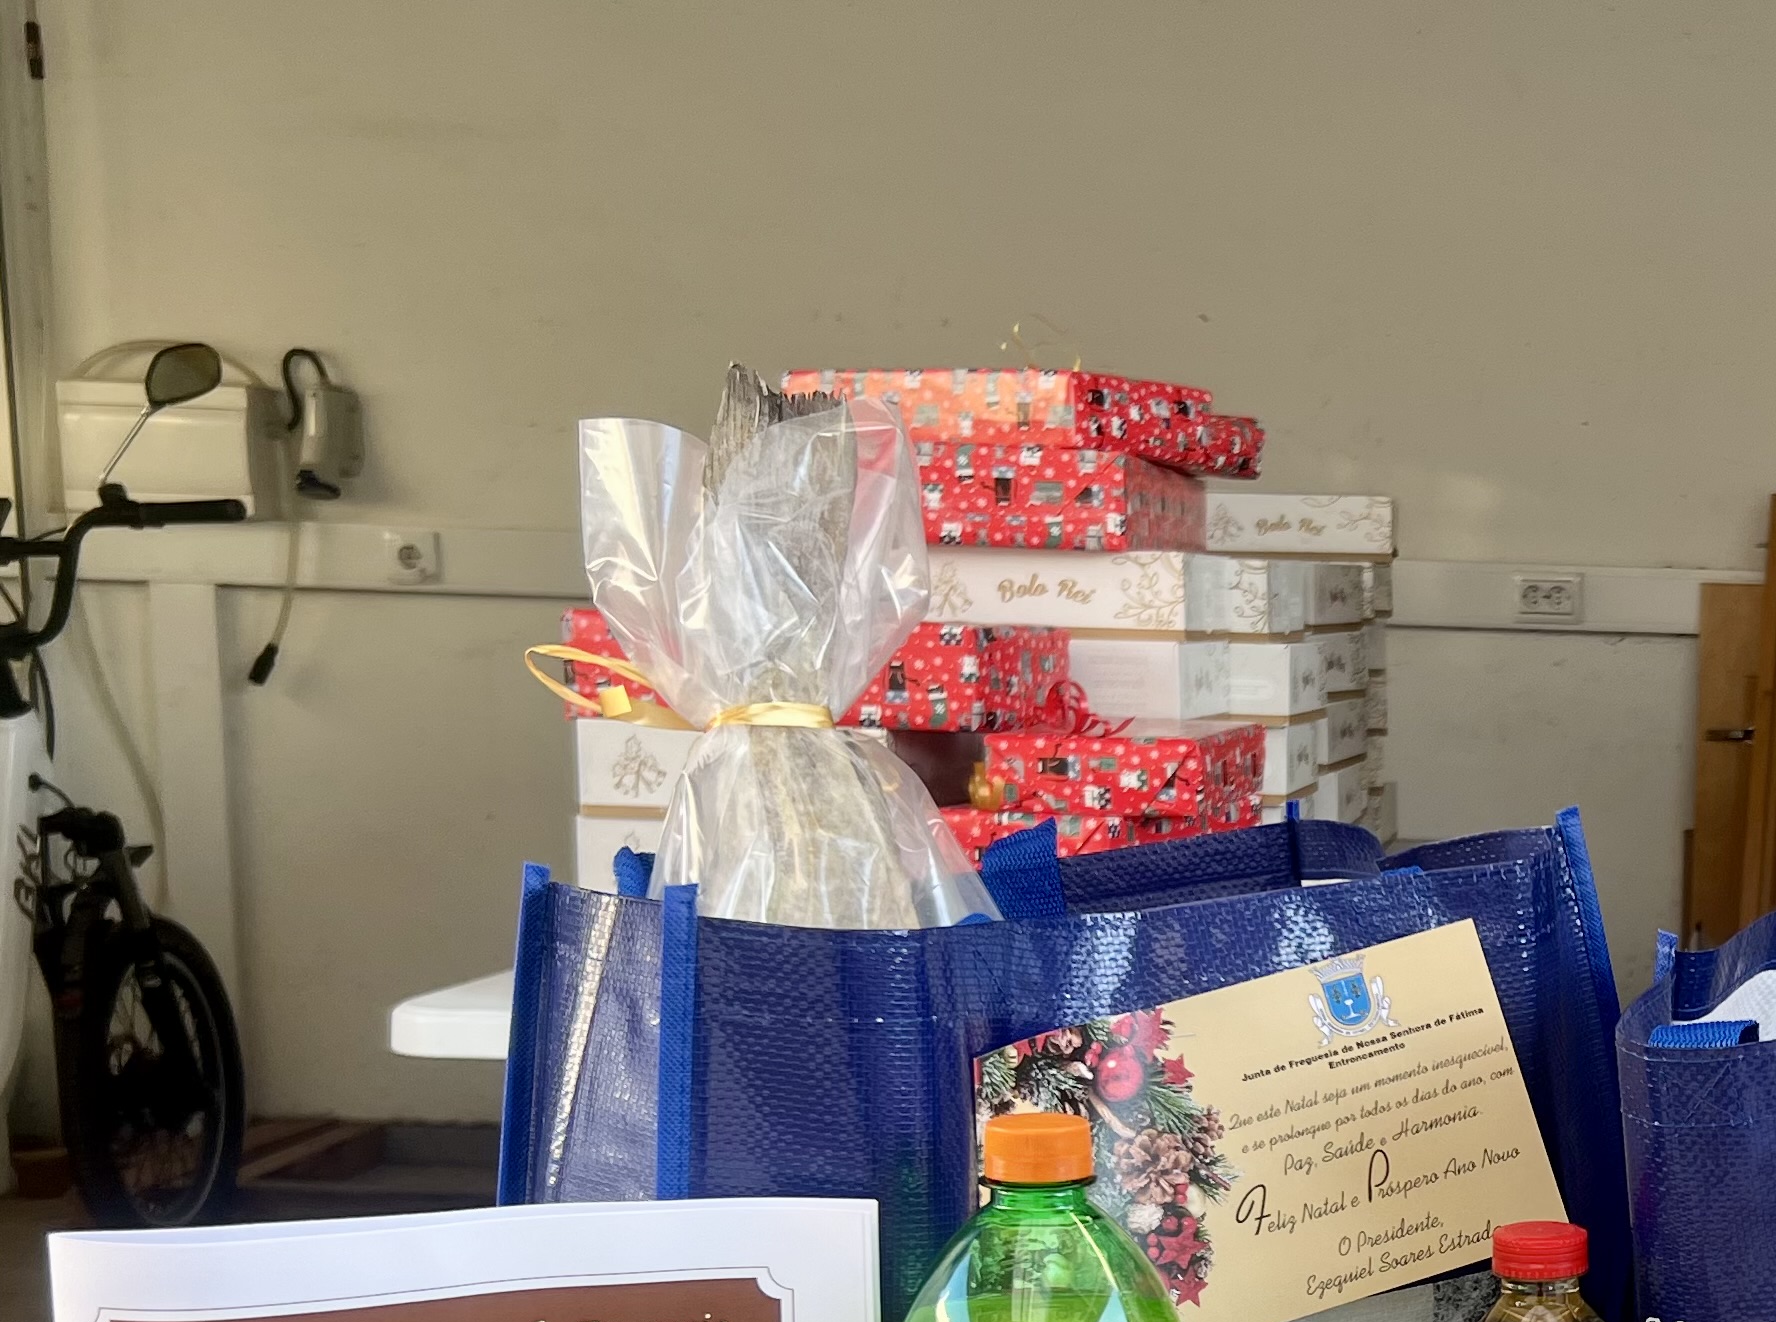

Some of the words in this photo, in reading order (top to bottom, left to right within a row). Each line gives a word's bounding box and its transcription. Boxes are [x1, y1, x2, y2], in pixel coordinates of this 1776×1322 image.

[1301, 1191, 1346, 1223] Natal
[1351, 1196, 1360, 1208] e
[1443, 1158, 1477, 1180] Ano
[1482, 1147, 1521, 1168] Novo
[1306, 1258, 1374, 1299] Ezequiel
[1379, 1245, 1434, 1273] Soares
[1339, 1237, 1352, 1256] O
